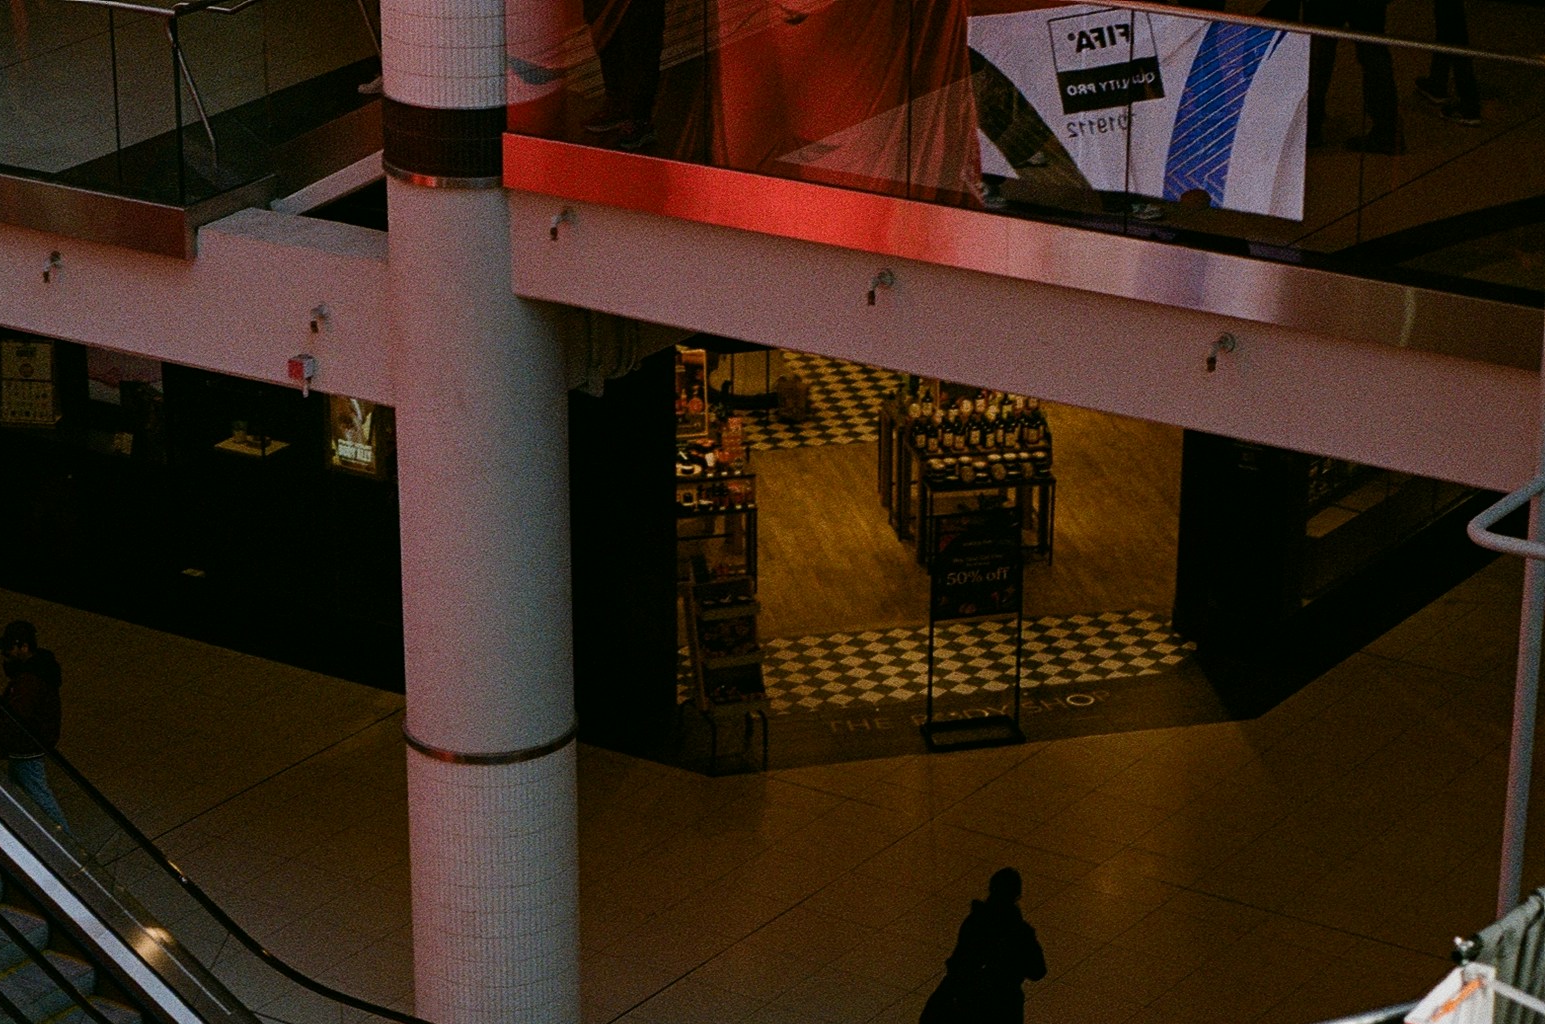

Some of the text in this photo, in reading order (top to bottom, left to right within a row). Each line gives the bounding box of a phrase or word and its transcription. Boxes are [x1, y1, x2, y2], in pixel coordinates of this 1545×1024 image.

[945, 565, 1011, 587] 50% off
[828, 717, 895, 733] THE
[1019, 690, 1112, 716] SHOP
